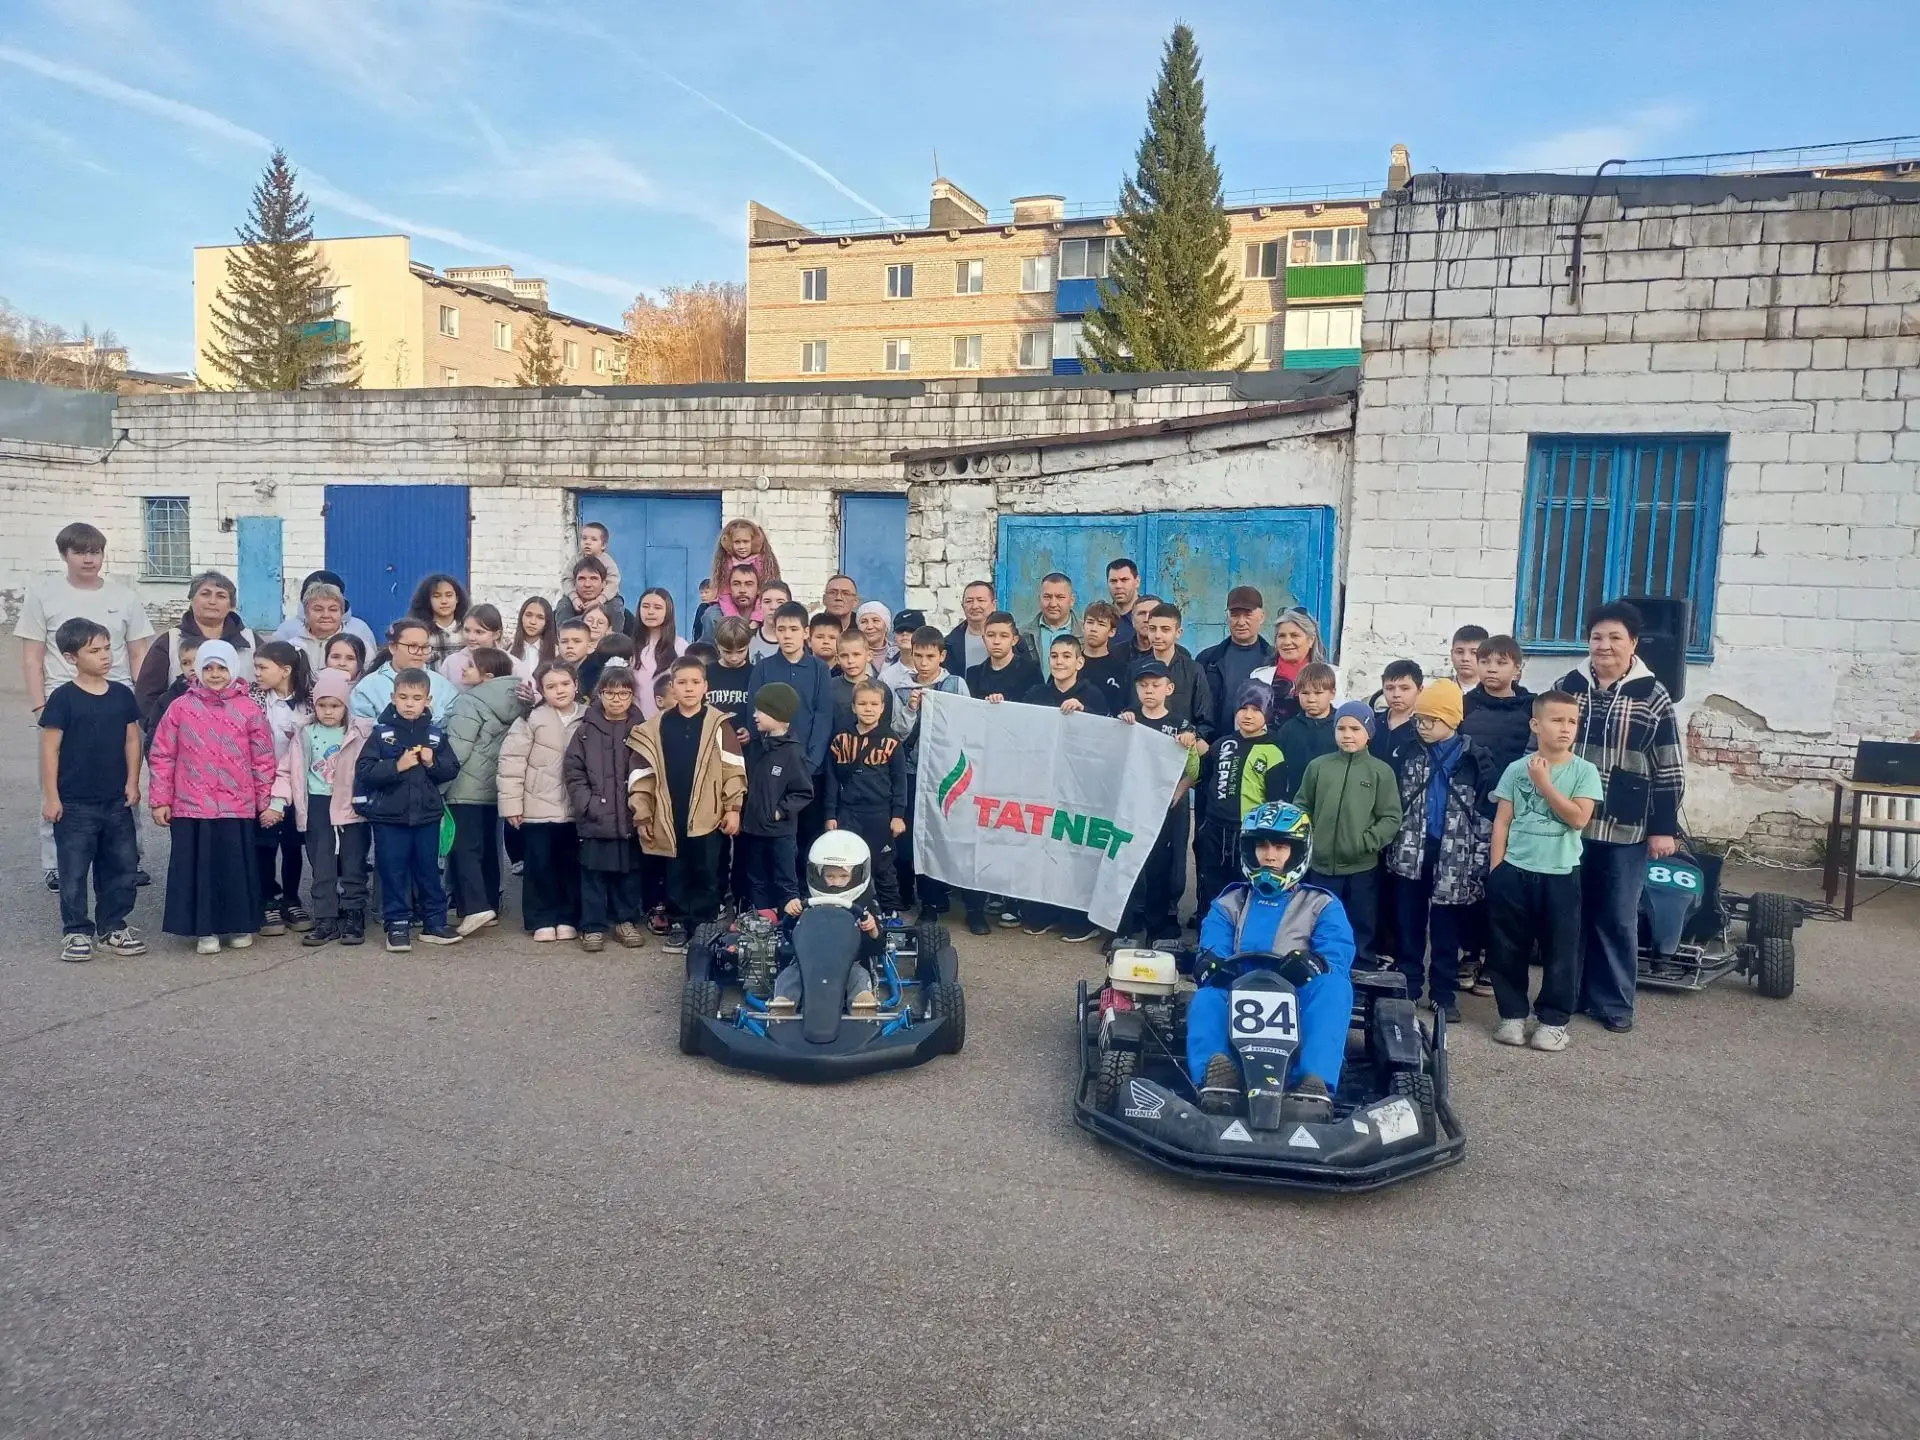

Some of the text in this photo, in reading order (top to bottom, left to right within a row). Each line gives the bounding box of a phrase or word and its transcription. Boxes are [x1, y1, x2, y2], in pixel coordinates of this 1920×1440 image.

[1648, 867, 1696, 888] 86
[1233, 999, 1295, 1035] 84
[1125, 1108, 1161, 1119] HONDA
